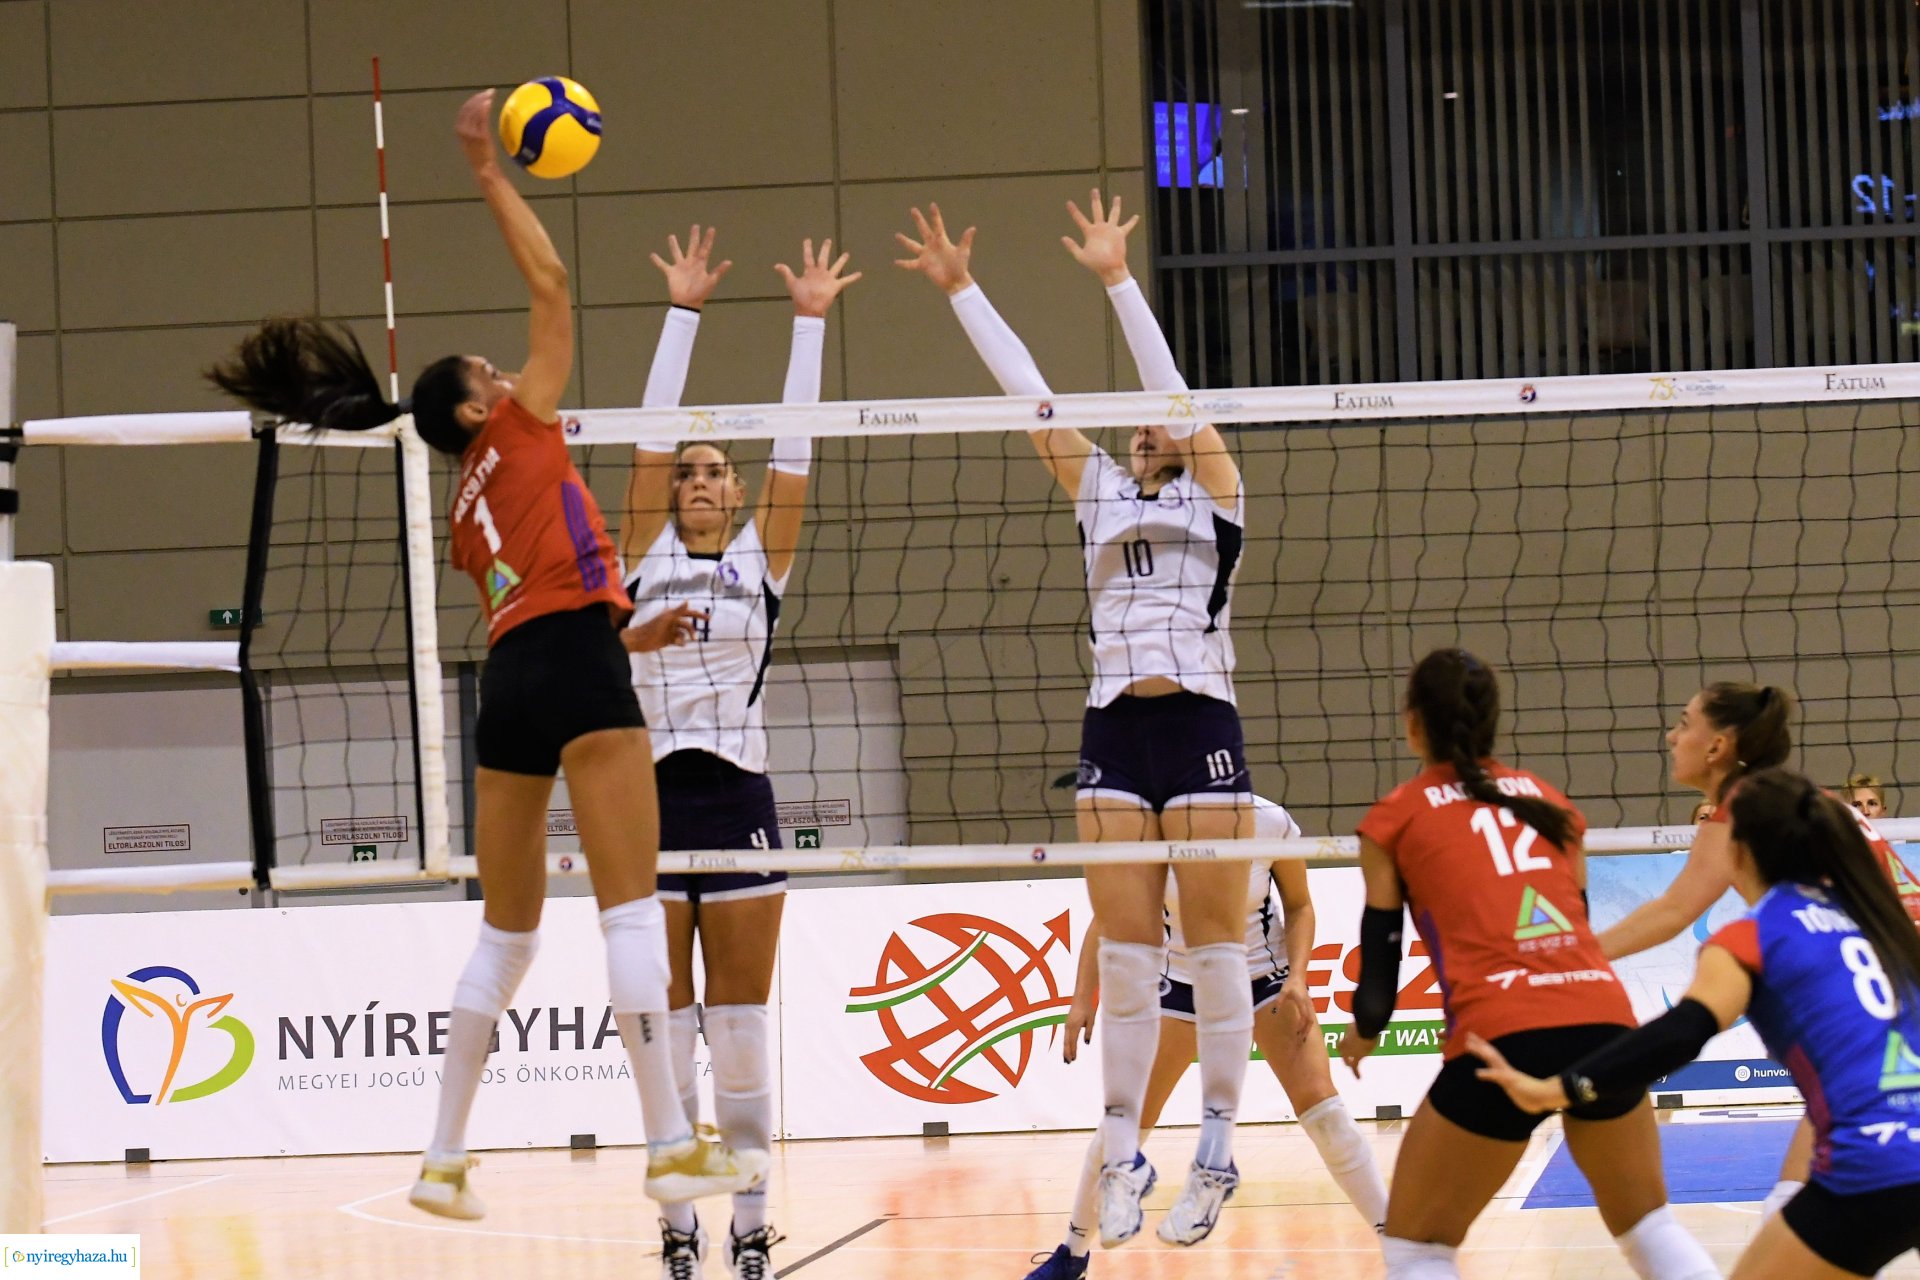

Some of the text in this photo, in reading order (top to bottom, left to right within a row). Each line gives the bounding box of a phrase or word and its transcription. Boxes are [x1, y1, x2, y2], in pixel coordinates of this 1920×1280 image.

[474, 495, 502, 554] 1
[1124, 539, 1153, 578] 10
[108, 840, 163, 850] ELTORLASZOLNI
[1470, 807, 1552, 876] 12
[1840, 936, 1897, 1020] 8
[278, 1073, 357, 1091] MEGYEI
[367, 1067, 425, 1088] JOGÚ
[1753, 1068, 1791, 1078] hunvol
